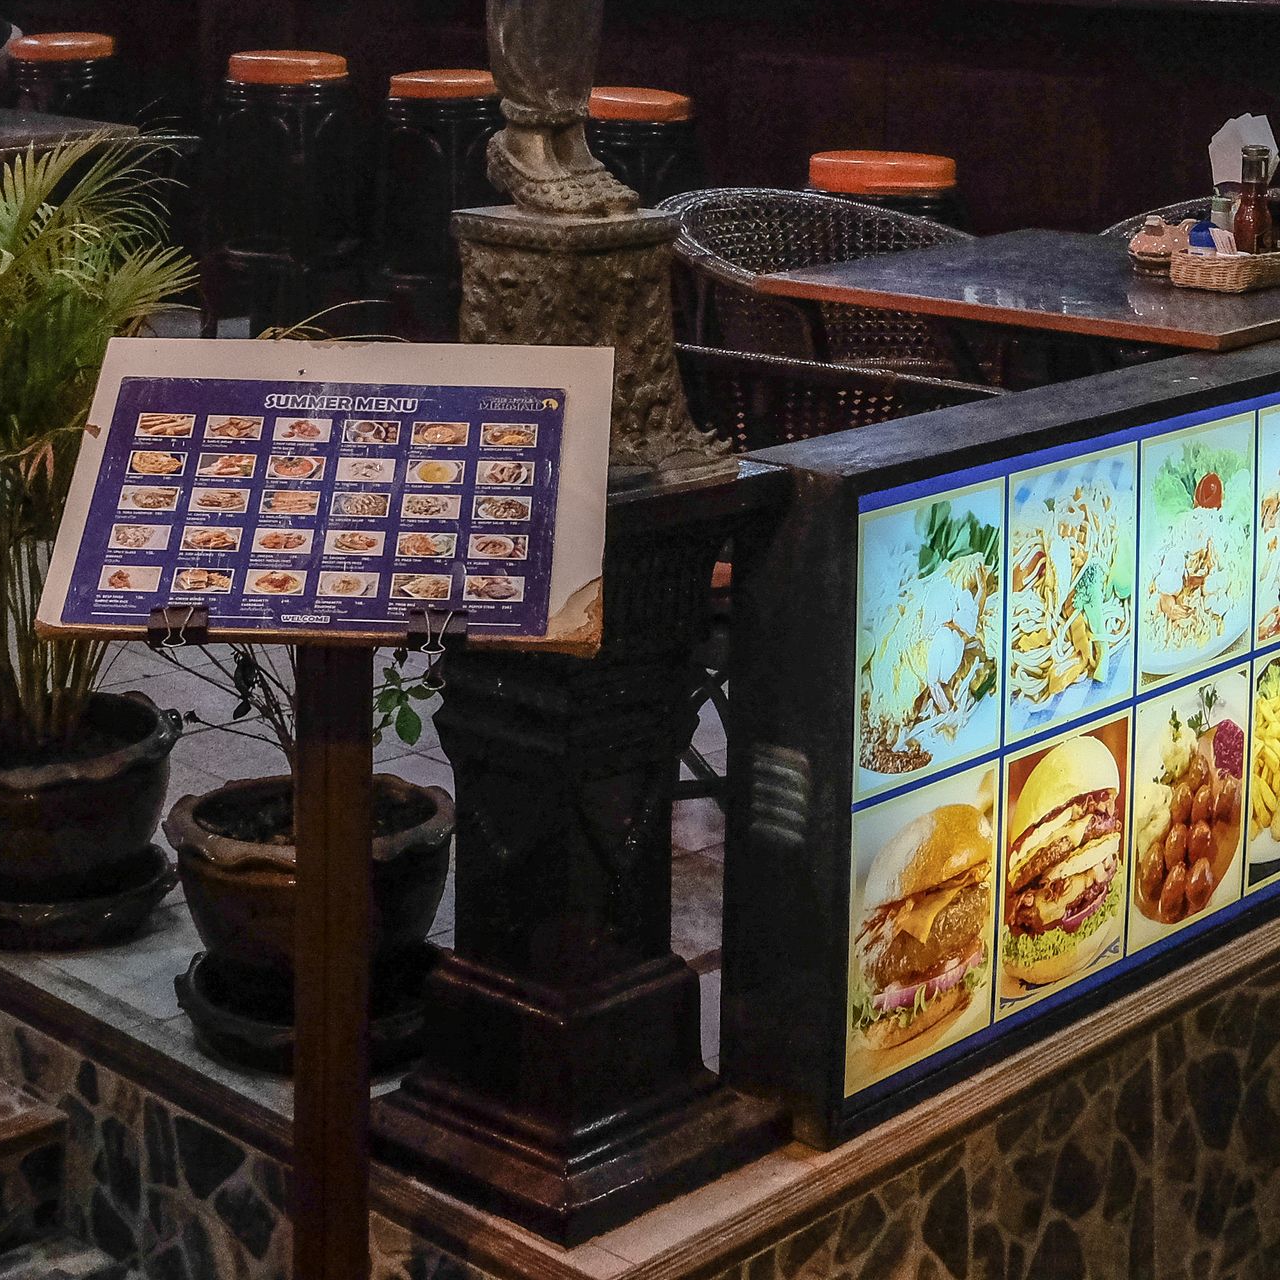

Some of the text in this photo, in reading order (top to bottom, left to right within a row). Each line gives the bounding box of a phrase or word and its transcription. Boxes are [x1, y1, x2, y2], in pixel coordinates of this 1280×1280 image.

[264, 393, 419, 413] SUMMER MENU
[280, 613, 331, 624] WELCOME
